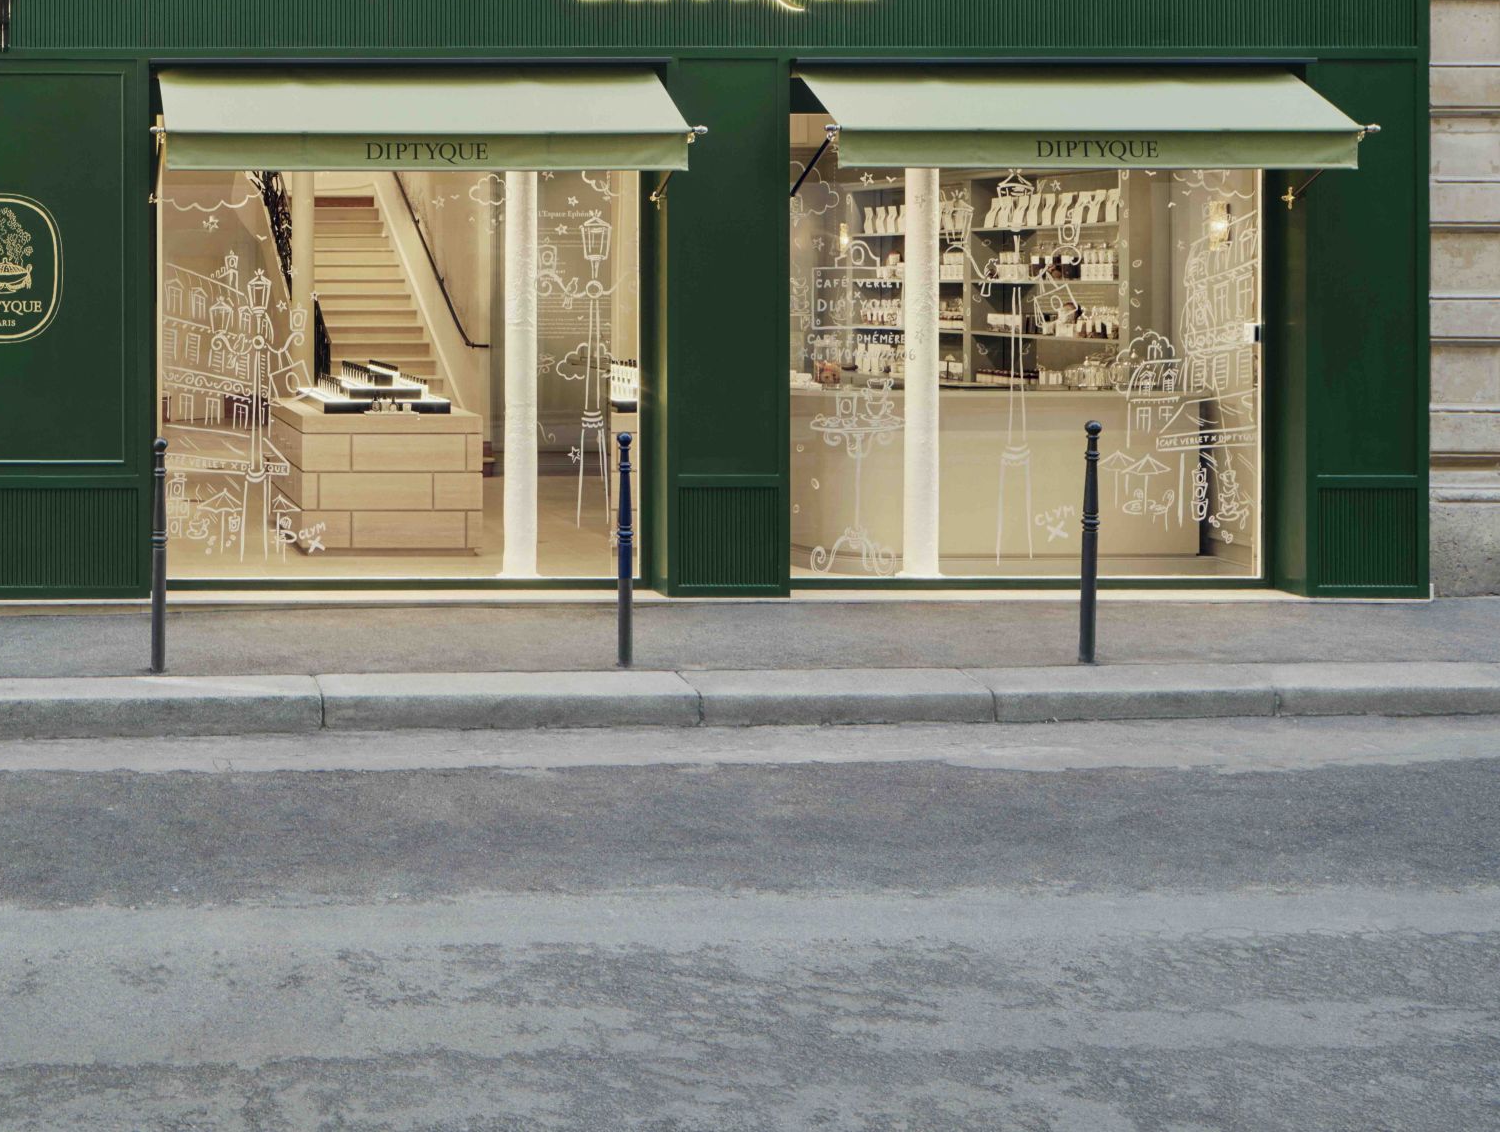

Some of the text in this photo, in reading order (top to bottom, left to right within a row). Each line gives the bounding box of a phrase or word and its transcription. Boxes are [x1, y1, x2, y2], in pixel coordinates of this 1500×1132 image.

[365, 142, 489, 165] DIPTYQUE
[1036, 140, 1159, 162] DIPTYQUE
[815, 275, 900, 289] CAFÉ VERLET
[298, 521, 326, 541] CLYM
